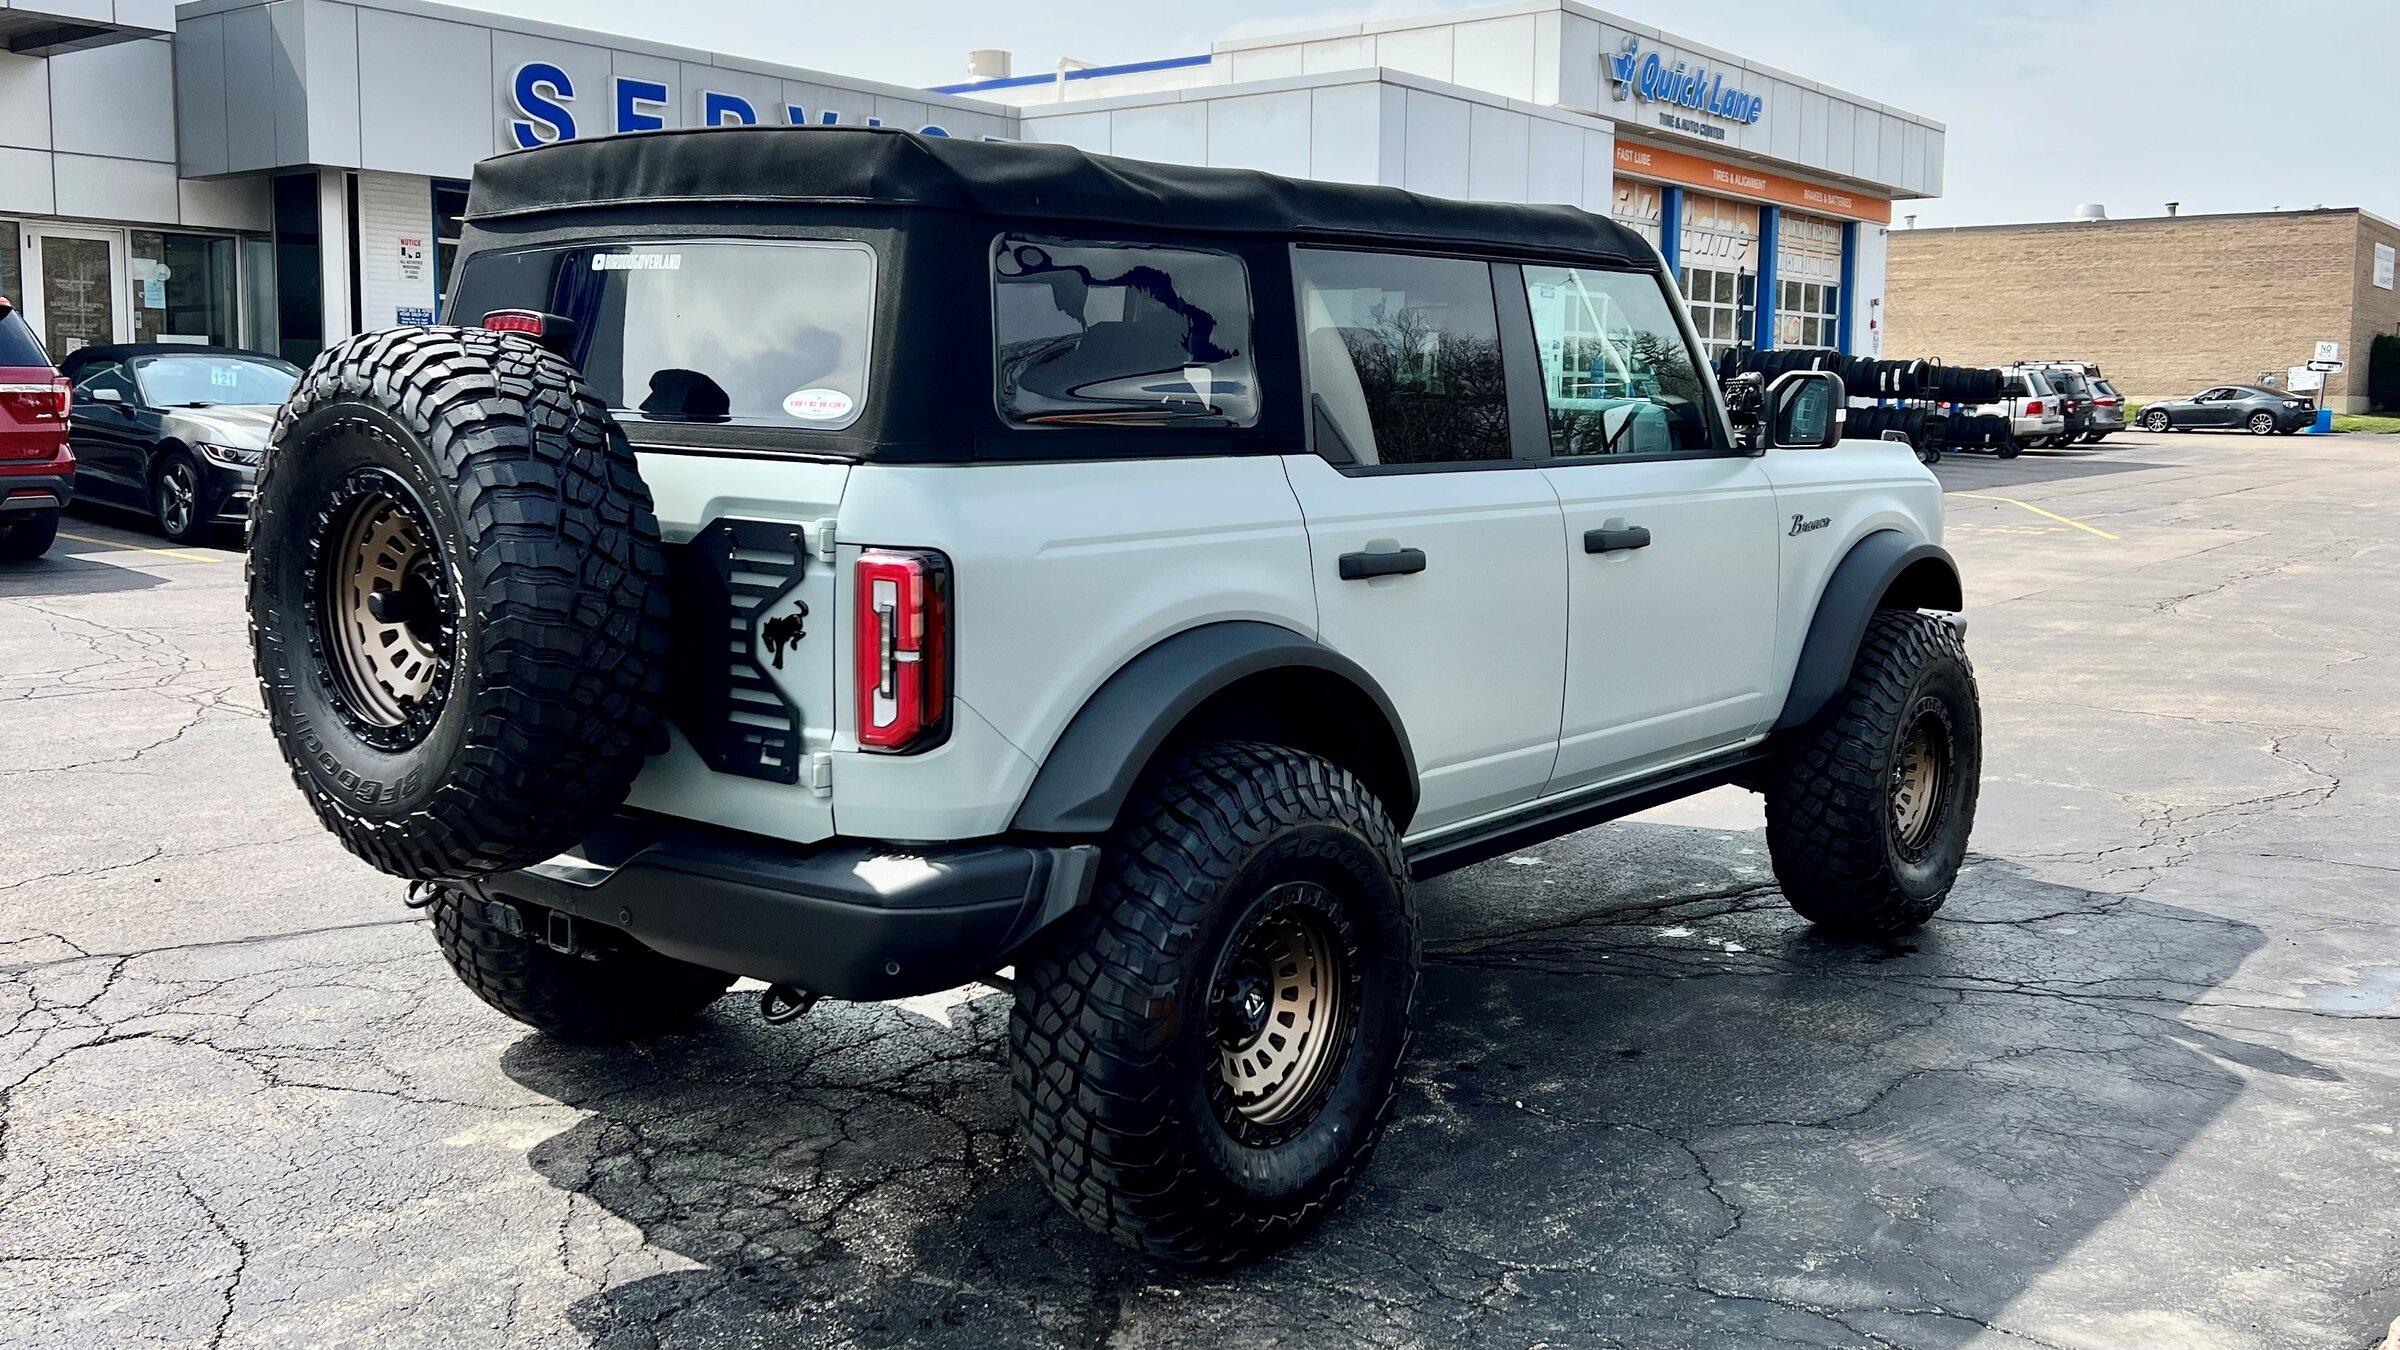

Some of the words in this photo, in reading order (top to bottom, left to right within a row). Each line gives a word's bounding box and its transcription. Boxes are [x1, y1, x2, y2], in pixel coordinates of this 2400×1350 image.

[1638, 50, 1711, 111] Quick
[1706, 71, 1763, 125] Lane
[1658, 112, 1675, 127] TIRE
[1681, 118, 1699, 134] AUTO
[1699, 123, 1726, 140] CENTER
[1616, 147, 1634, 162] FAST
[1634, 151, 1651, 167] LUBE
[1712, 168, 1730, 183] TIRES
[1734, 174, 1767, 190] ALIGNMENT
[1803, 189, 1823, 203] BRAKES
[1827, 194, 1852, 209] BATTERIES
[400, 238, 421, 247] NOTICE
[1788, 514, 1832, 537] Bronco
